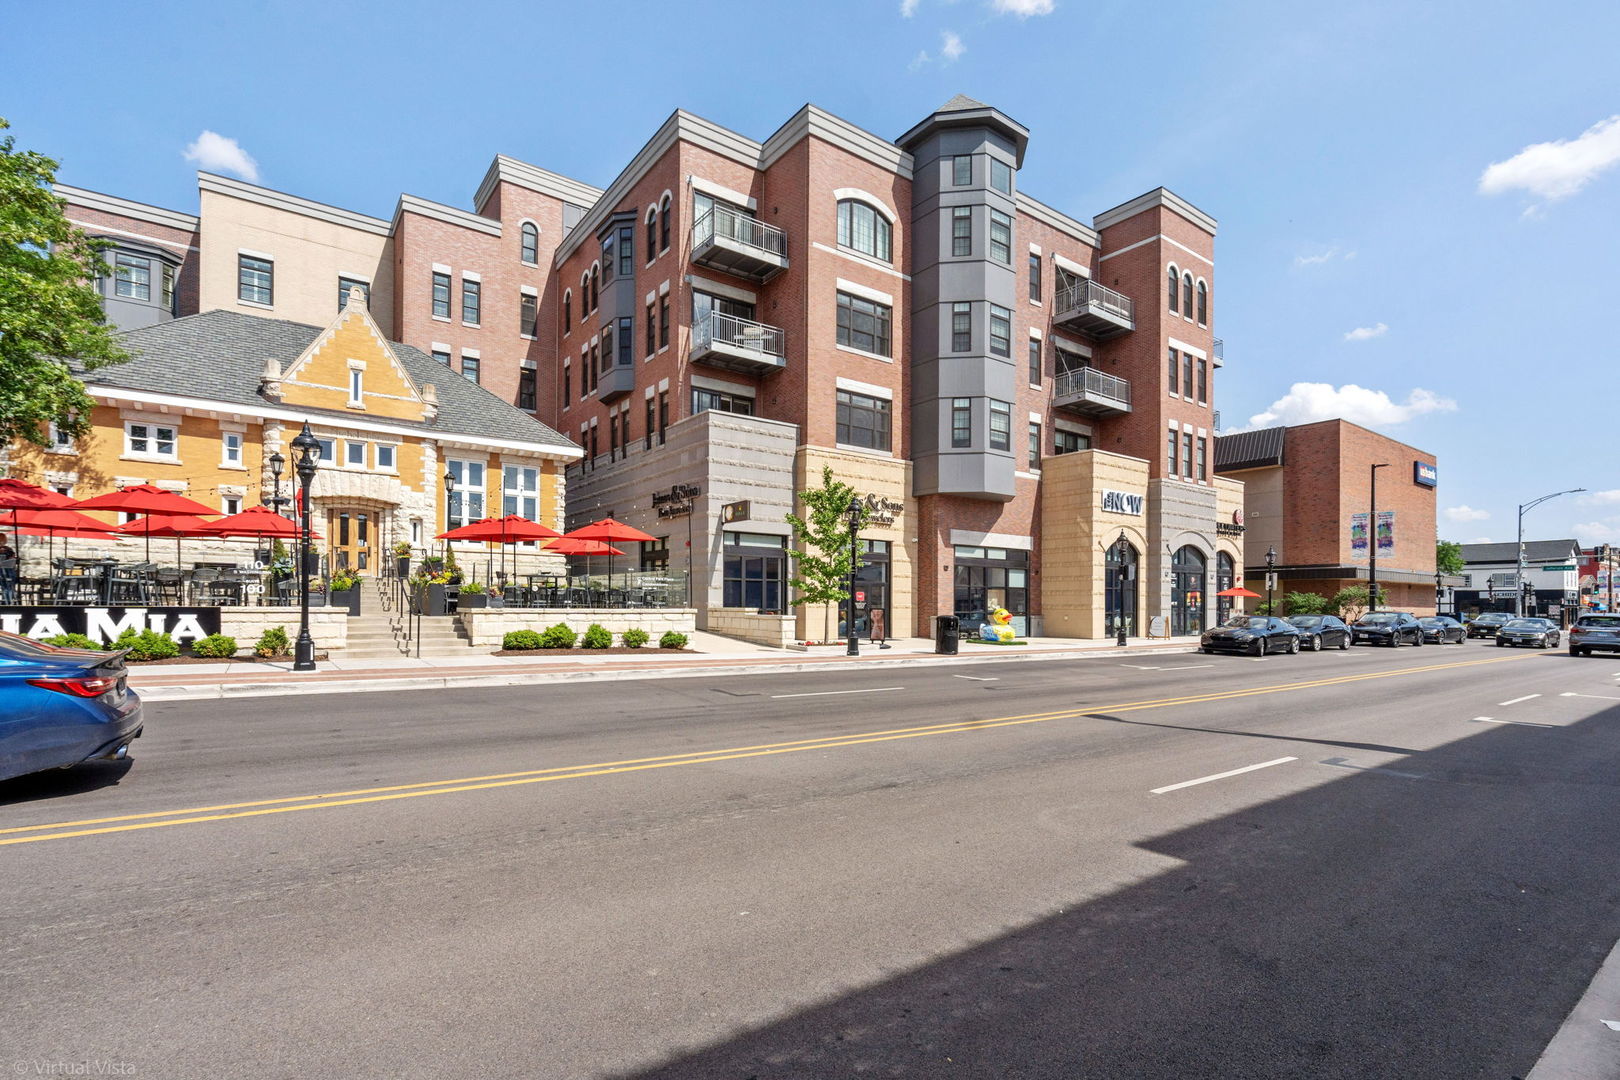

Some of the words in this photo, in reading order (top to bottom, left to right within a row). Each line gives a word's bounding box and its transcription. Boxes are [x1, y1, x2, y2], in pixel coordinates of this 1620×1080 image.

[881, 497, 904, 511] Sons
[244, 560, 264, 570] 110
[241, 584, 265, 594] 100
[84, 608, 209, 645] MIA
